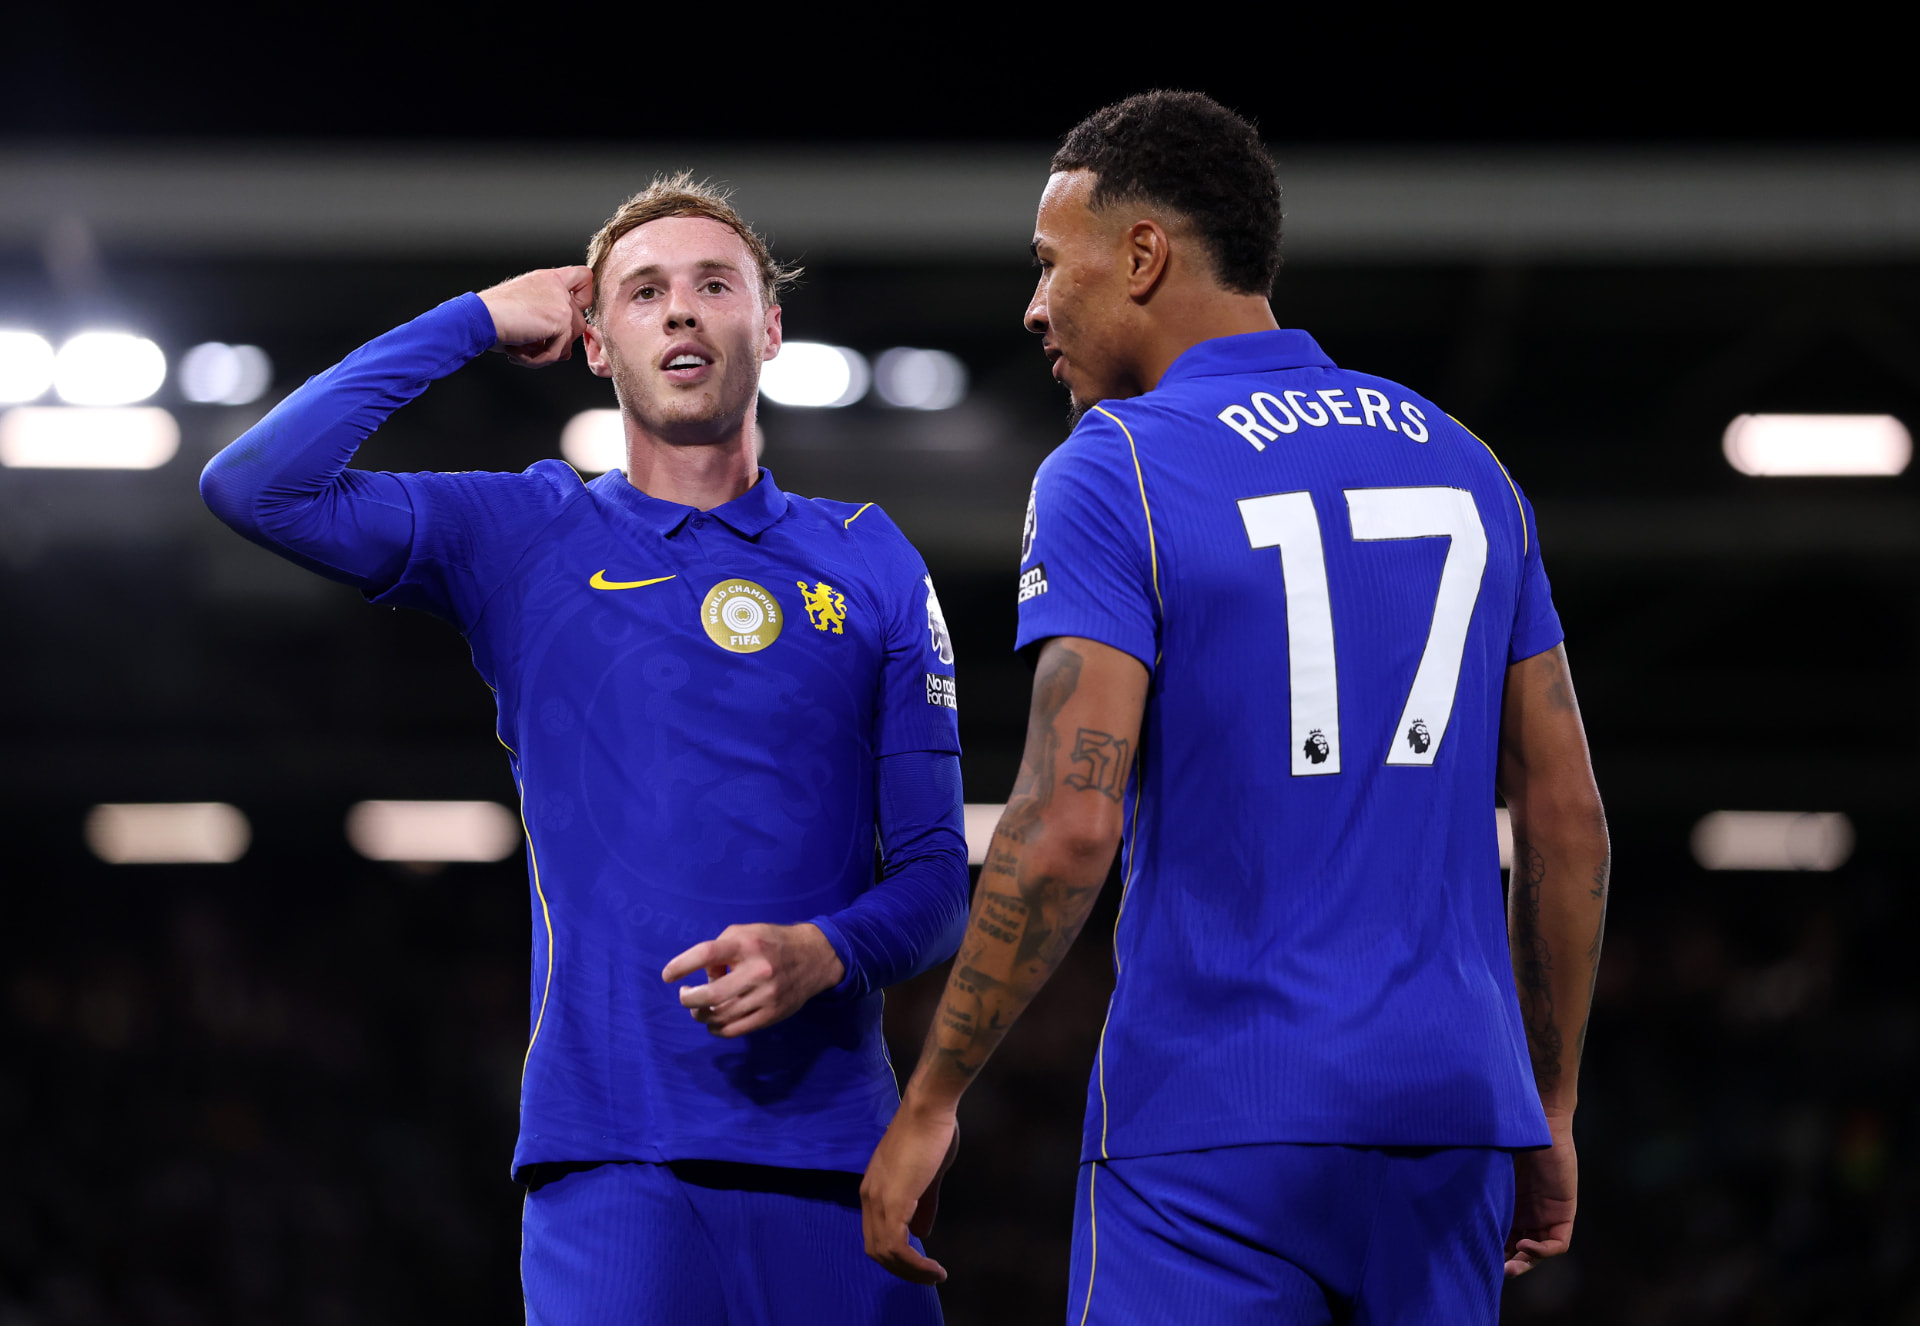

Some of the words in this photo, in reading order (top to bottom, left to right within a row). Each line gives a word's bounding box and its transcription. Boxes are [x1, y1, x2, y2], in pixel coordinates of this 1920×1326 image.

[1217, 387, 1430, 452] ROGERS
[708, 590, 727, 625] WORLD
[728, 584, 777, 624] CHAMPIONS
[729, 634, 761, 646] FIFA
[1235, 485, 1489, 777] 17
[926, 673, 942, 691] No
[927, 688, 942, 706] For
[1064, 727, 1129, 804] 51
